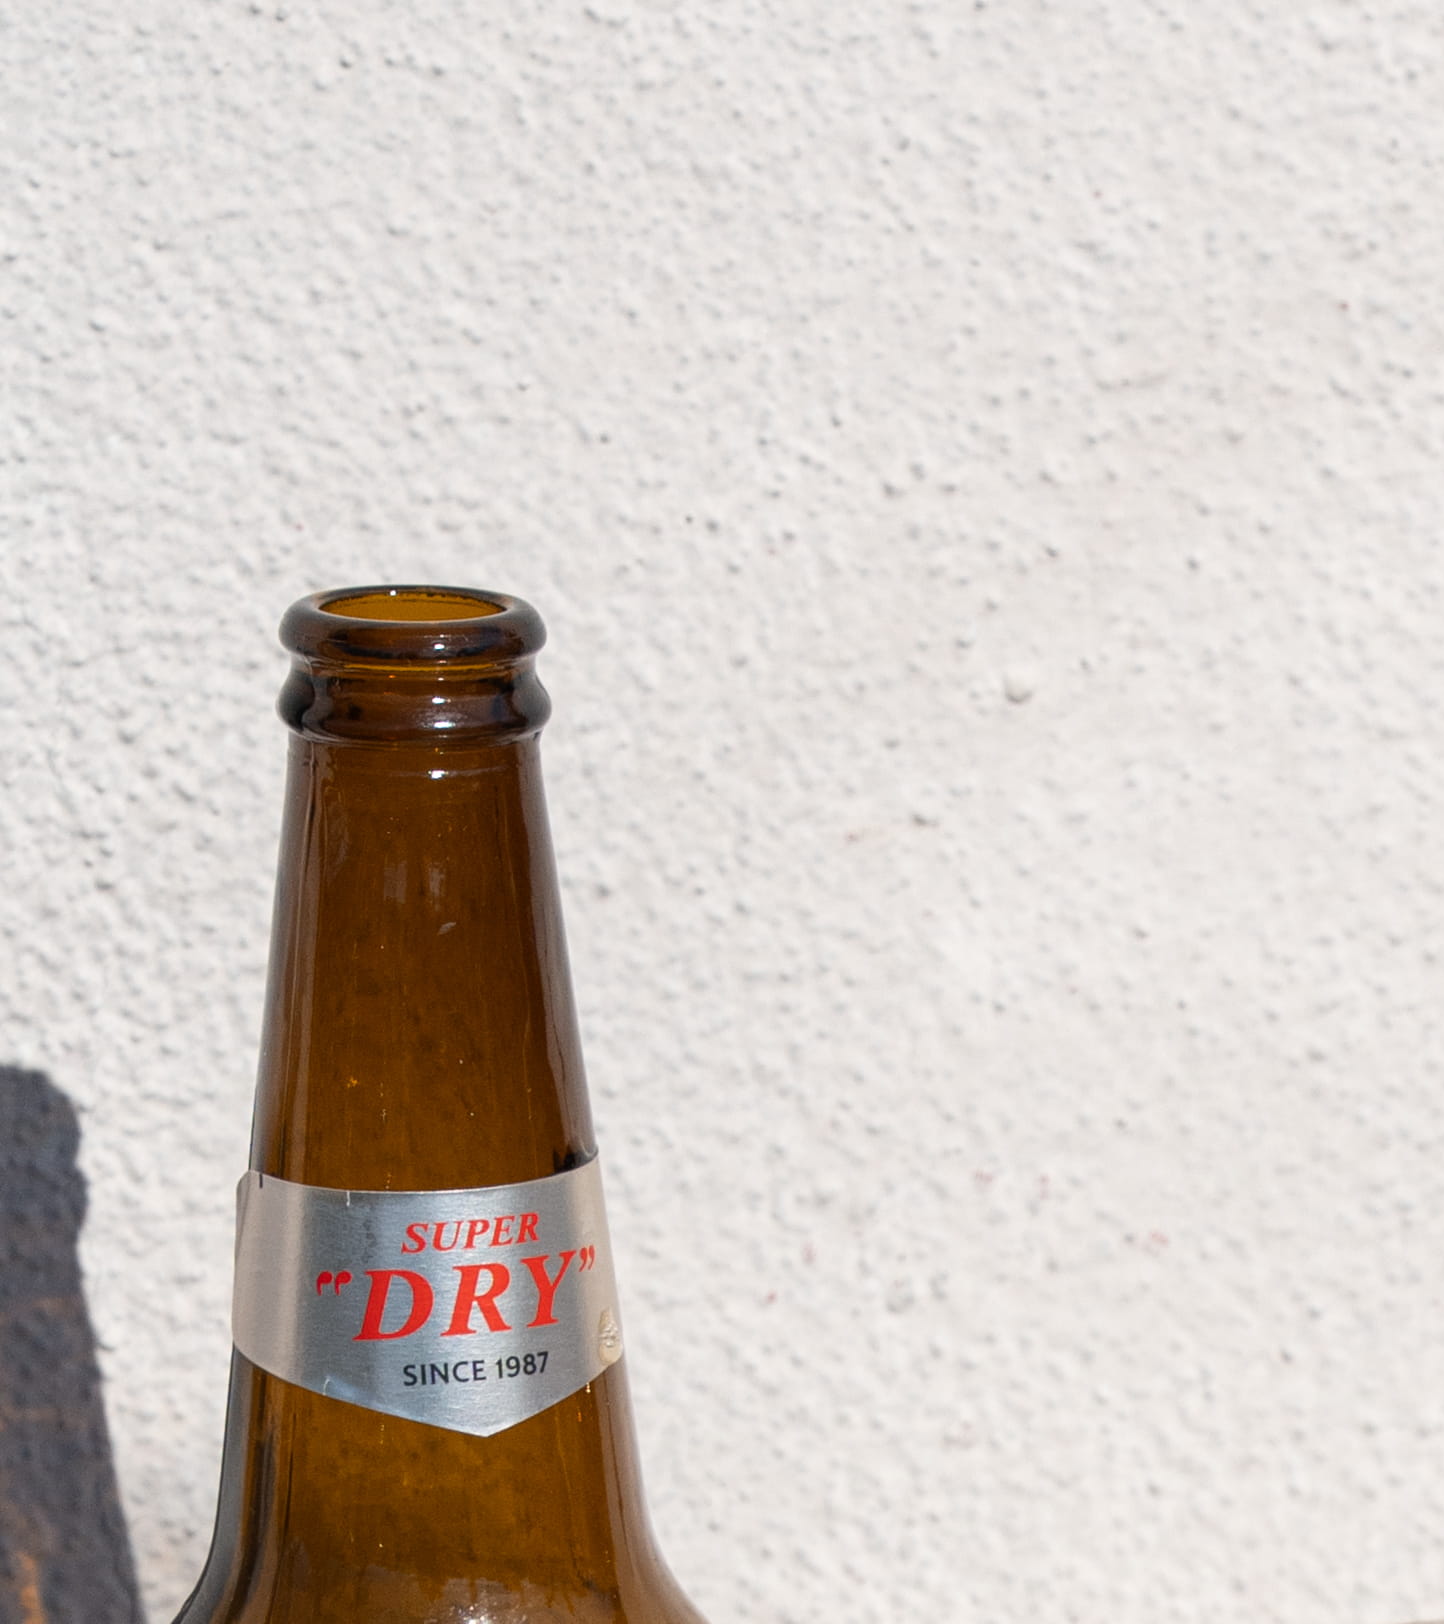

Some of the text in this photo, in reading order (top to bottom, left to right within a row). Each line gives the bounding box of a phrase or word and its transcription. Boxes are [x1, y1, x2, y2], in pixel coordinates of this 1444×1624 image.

[401, 1212, 540, 1254] SUPER
[403, 1352, 549, 1387] SINCE 1987
